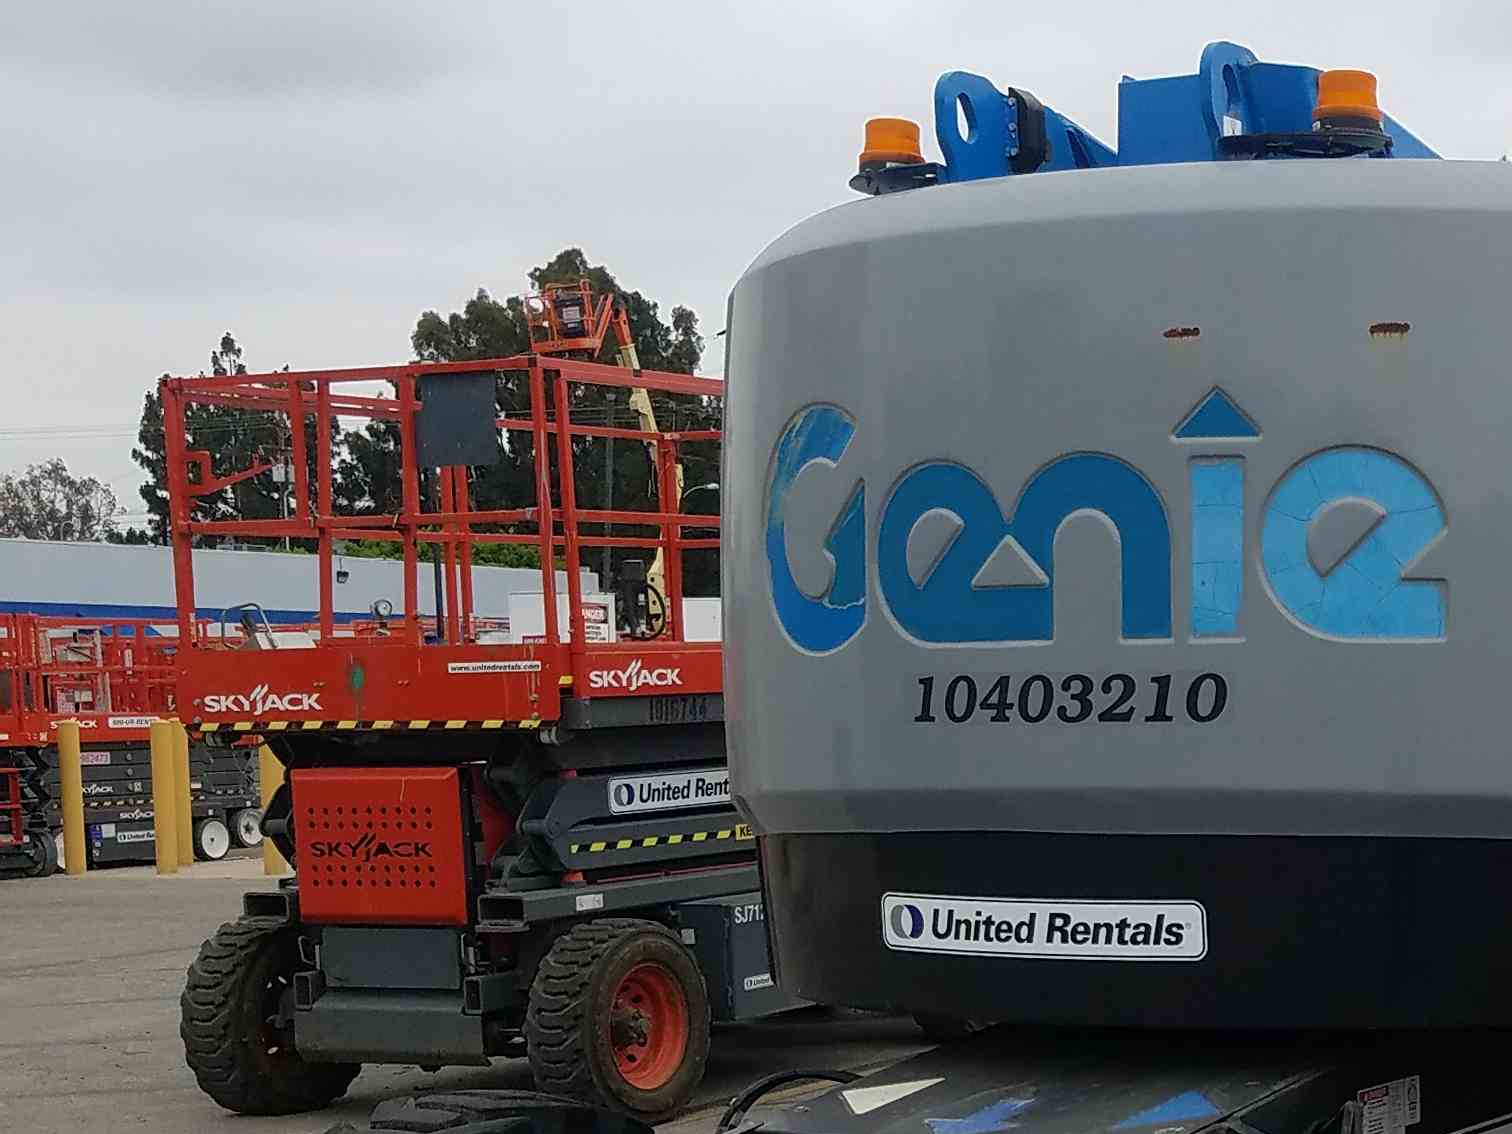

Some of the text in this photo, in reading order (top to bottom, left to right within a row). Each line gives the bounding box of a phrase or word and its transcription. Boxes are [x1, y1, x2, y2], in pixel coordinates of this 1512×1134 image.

[766, 388, 1448, 656] Genie
[589, 659, 683, 692] SKYJACK
[204, 684, 323, 716] SKYJACK
[913, 672, 1229, 724] 10403210
[639, 779, 691, 804] United
[311, 832, 433, 862] SKYJACK
[932, 907, 1184, 947] United Rentals
